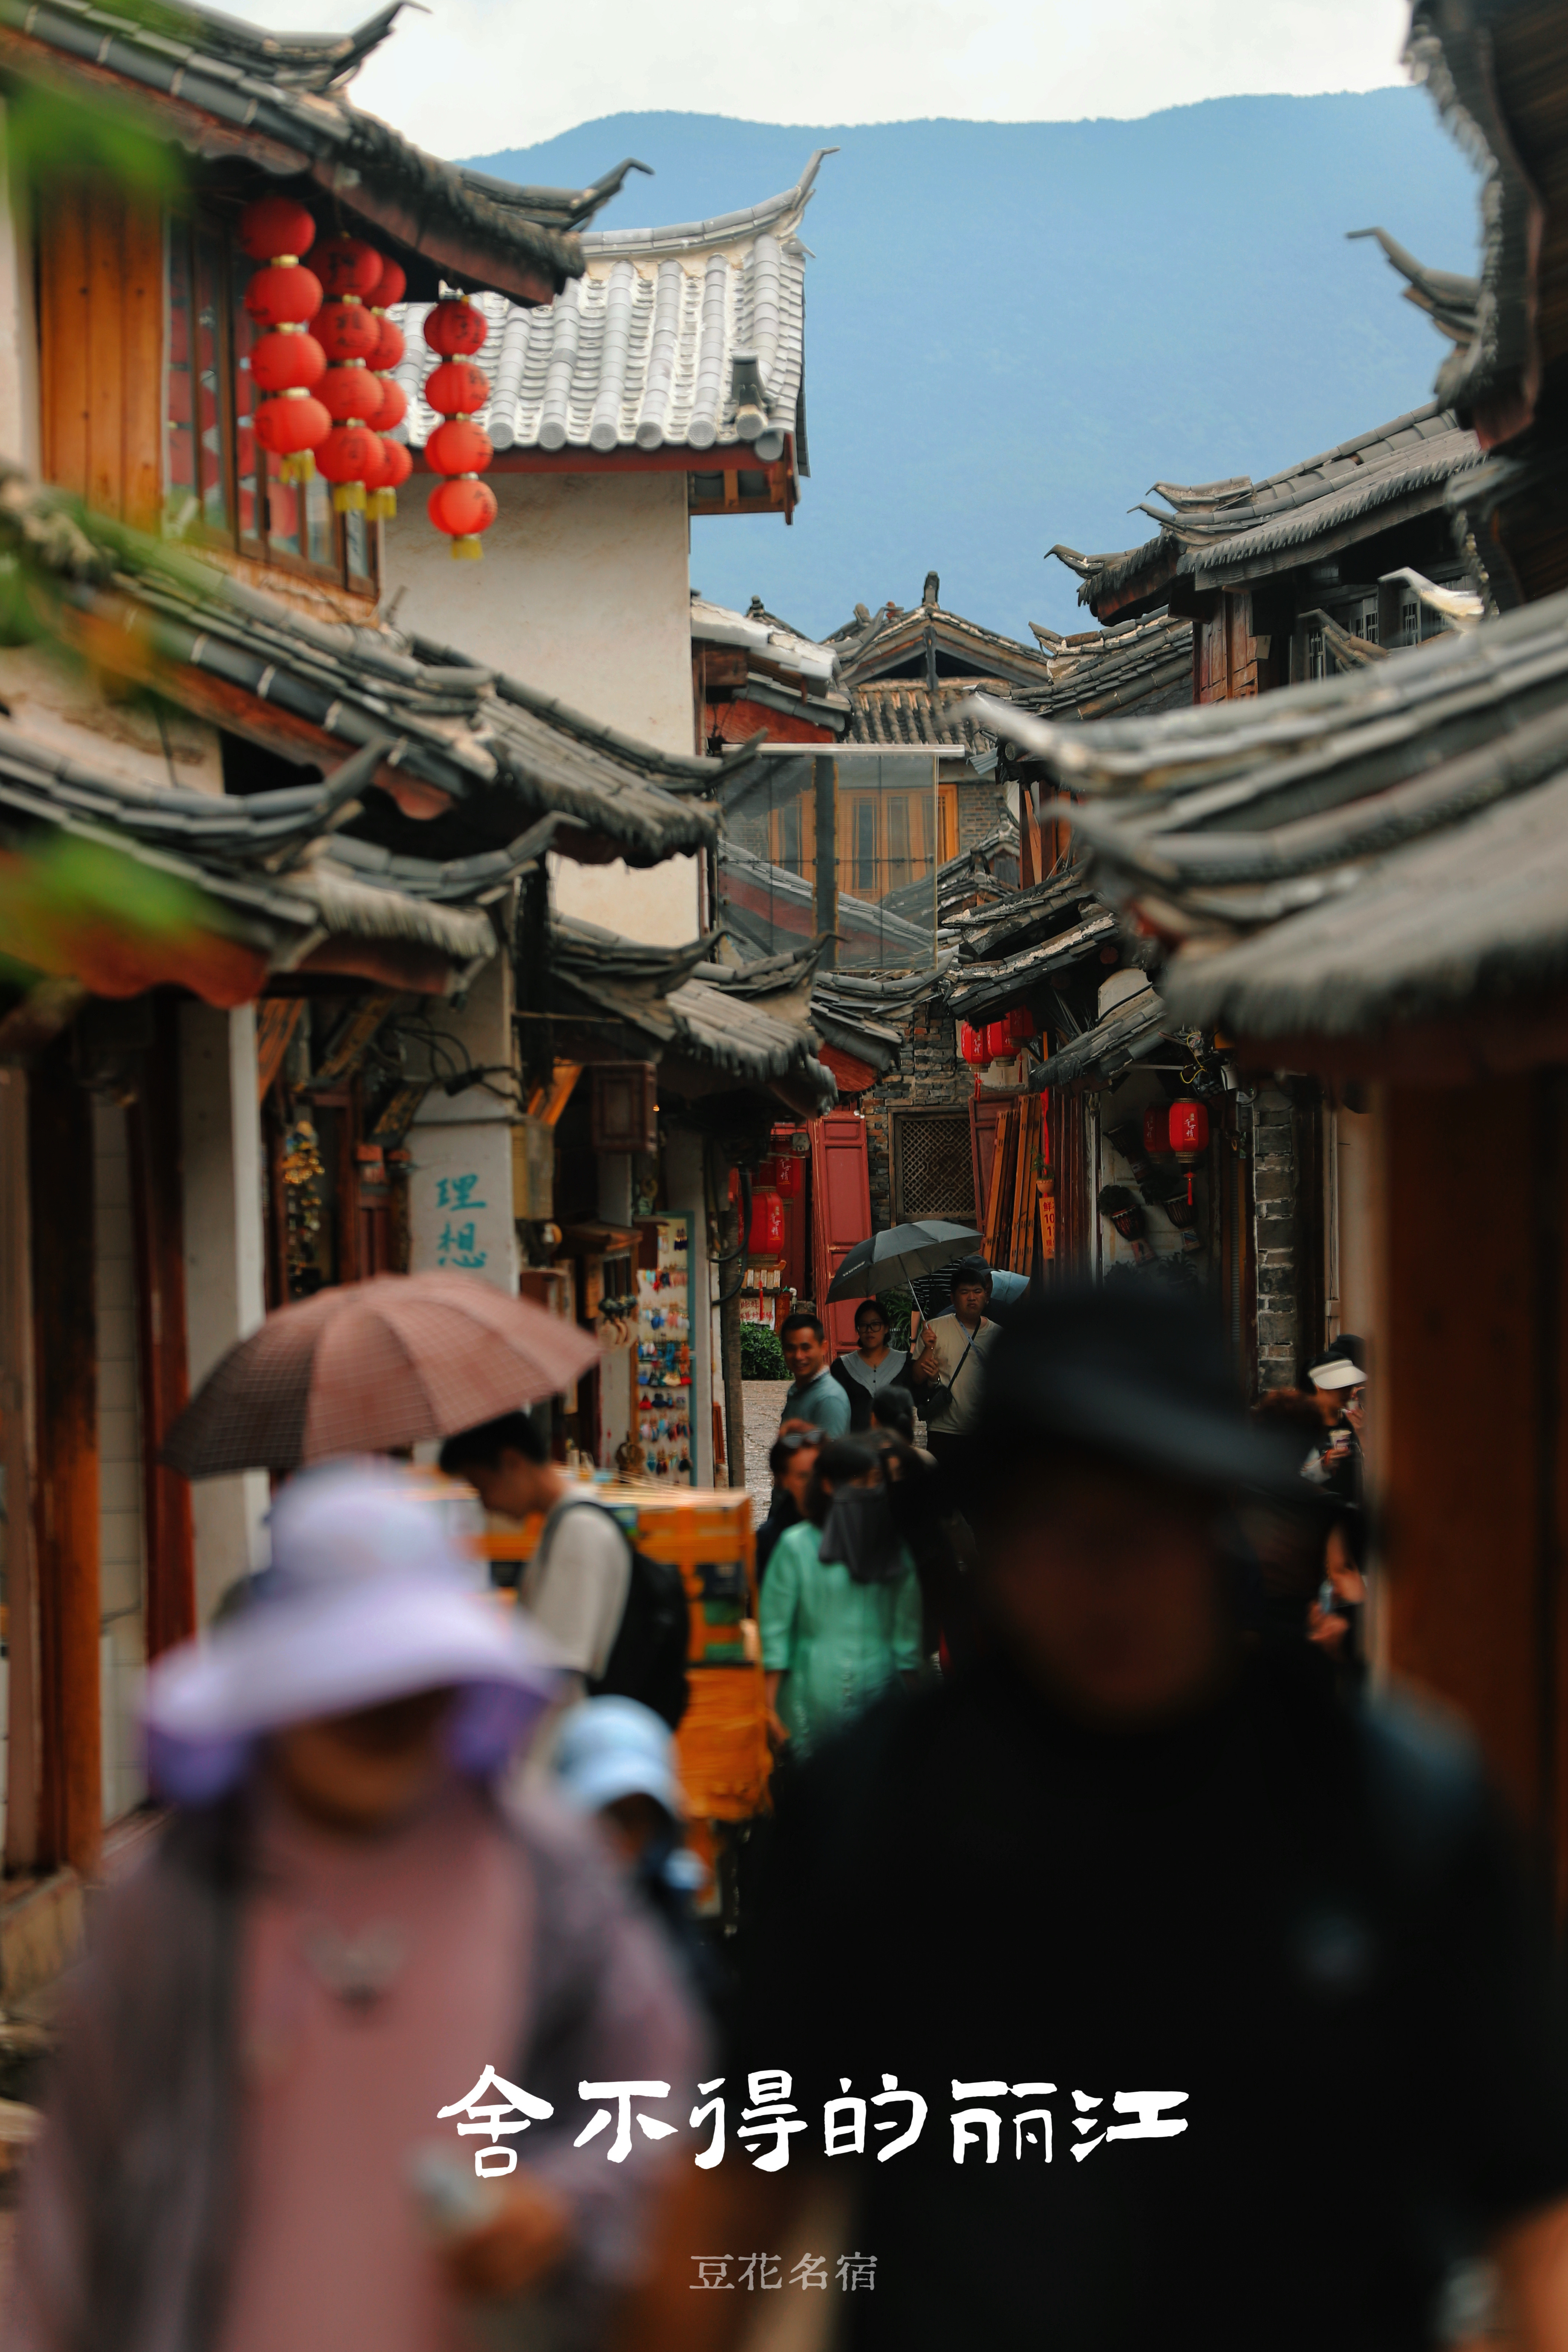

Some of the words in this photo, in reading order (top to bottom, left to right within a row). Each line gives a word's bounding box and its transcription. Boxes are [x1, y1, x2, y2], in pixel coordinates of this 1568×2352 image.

[1184, 1119, 1196, 1137] 千古情
[778, 1159, 791, 1181] 千古情
[1043, 1202, 1054, 1211] 鲜
[435, 1173, 487, 1268] 理想
[769, 1213, 781, 1236] 千古情
[1047, 1226, 1055, 1236] 1
